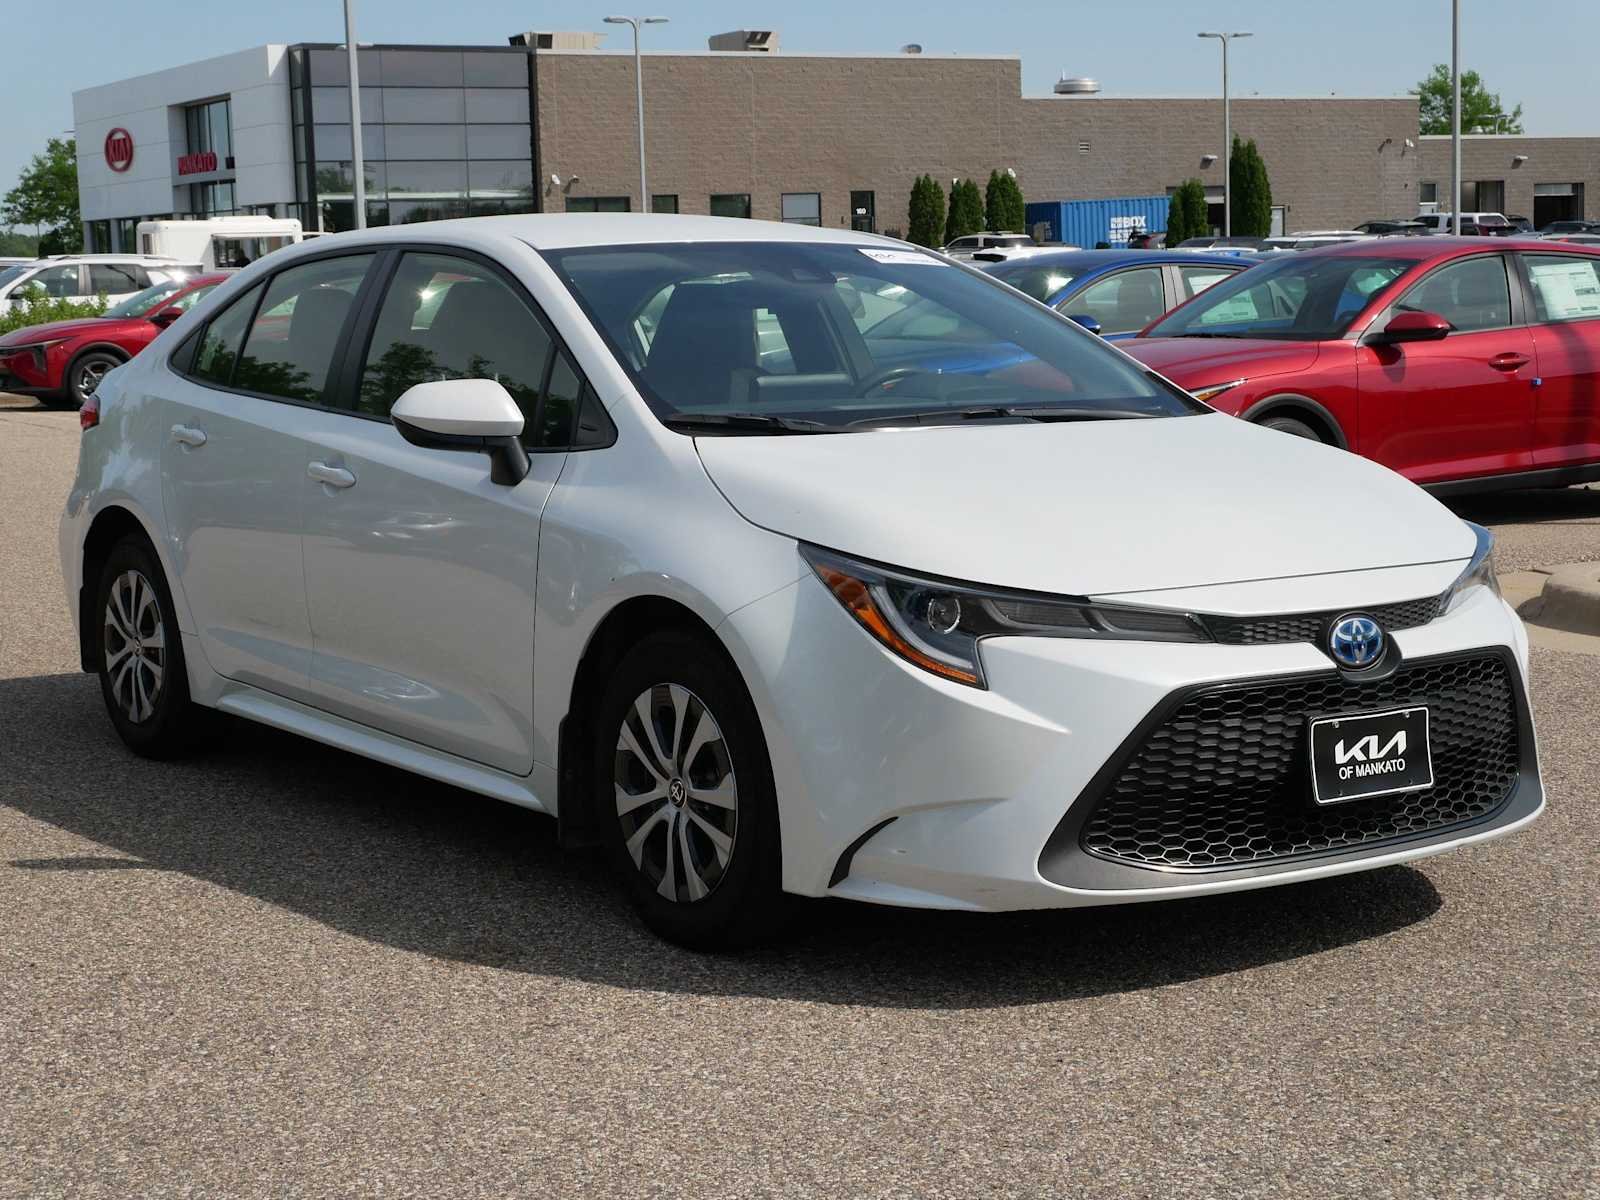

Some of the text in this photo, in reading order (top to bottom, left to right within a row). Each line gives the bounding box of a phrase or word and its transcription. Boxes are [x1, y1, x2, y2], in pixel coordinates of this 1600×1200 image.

[1334, 730, 1407, 765] KIA
[1338, 758, 1406, 780] OF MANKATO
